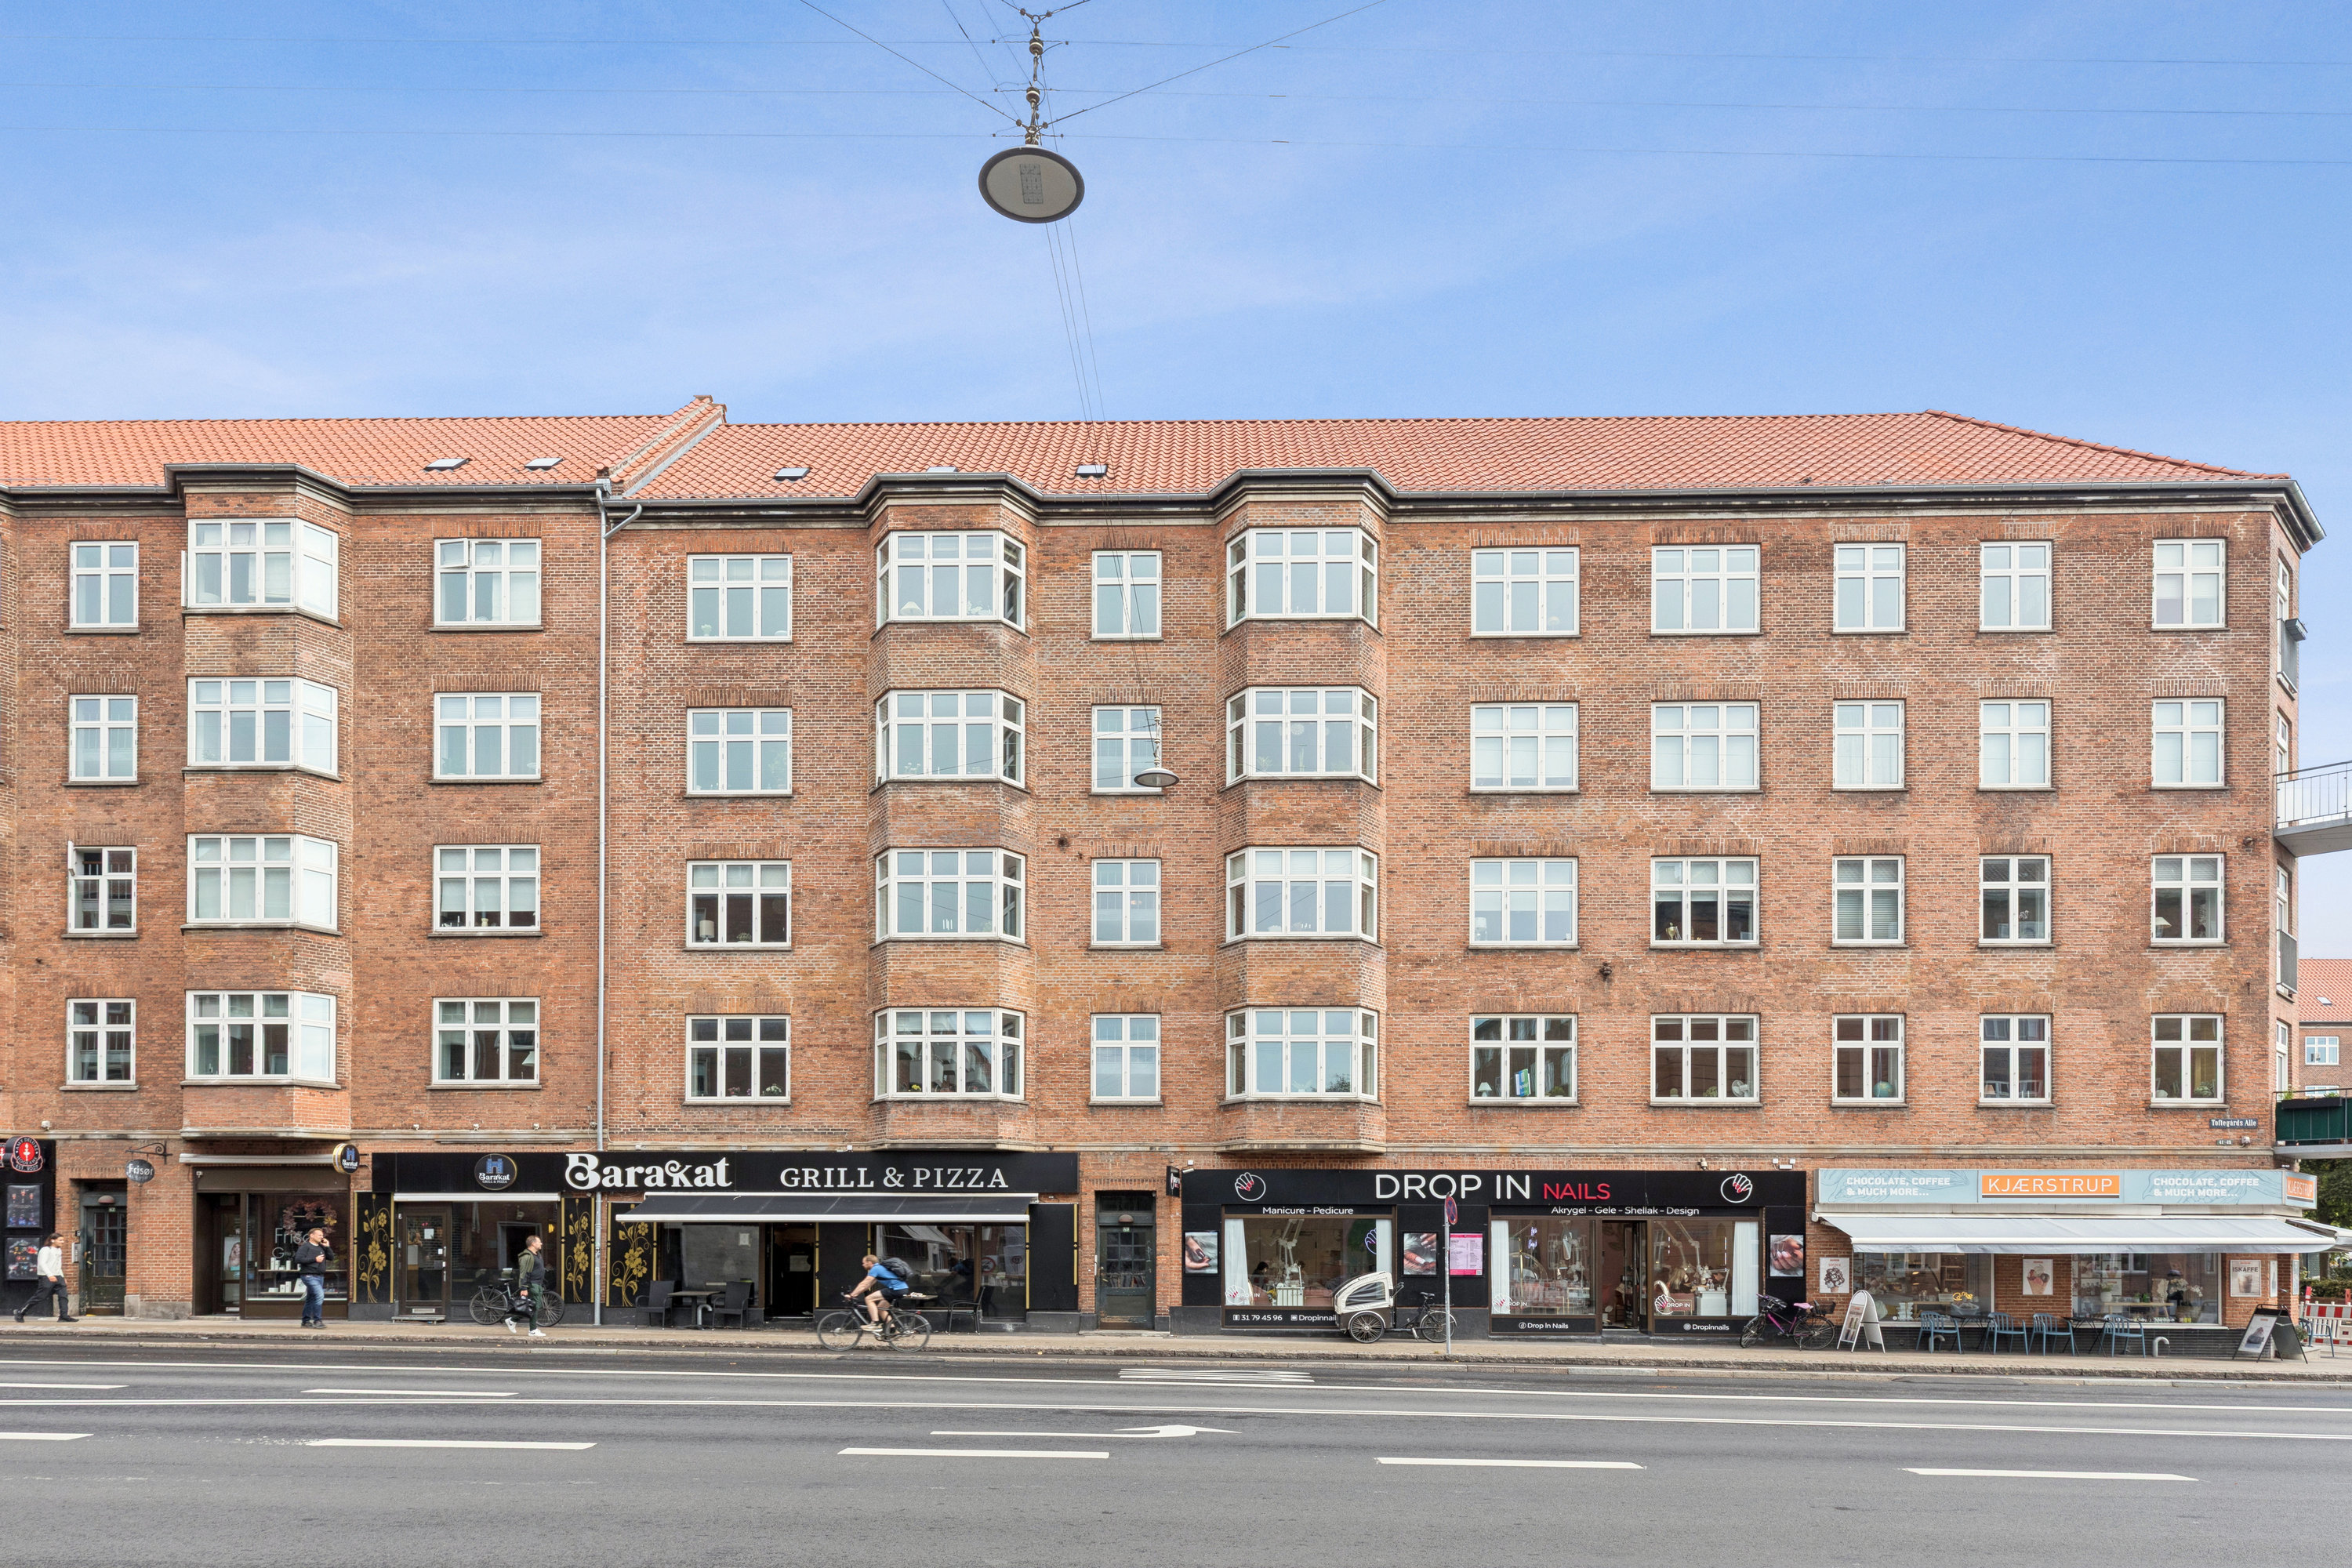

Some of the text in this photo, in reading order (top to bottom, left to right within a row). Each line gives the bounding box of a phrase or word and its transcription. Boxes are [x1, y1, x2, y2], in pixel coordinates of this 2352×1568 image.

[129, 1163, 153, 1175] Frisør
[564, 1153, 732, 1190] Barakat
[478, 1172, 510, 1181] Barakat
[780, 1167, 1008, 1188] GRILL & PIZZA
[1846, 1177, 1951, 1186] CHOCOLATE, COFFEE
[2154, 1178, 2259, 1187] CHOCOLATE, COFFEE
[1375, 1174, 1530, 1200] DROP IN
[1988, 1178, 2112, 1192] KJÆRSTRUP
[1543, 1183, 1610, 1200] NAILS
[1313, 1206, 1354, 1214] Pedicure
[1551, 1206, 1587, 1216] Akrygel
[1666, 1207, 1700, 1216] Design
[275, 1228, 309, 1244] Fris
[1298, 1314, 1337, 1323] Dropinnail
